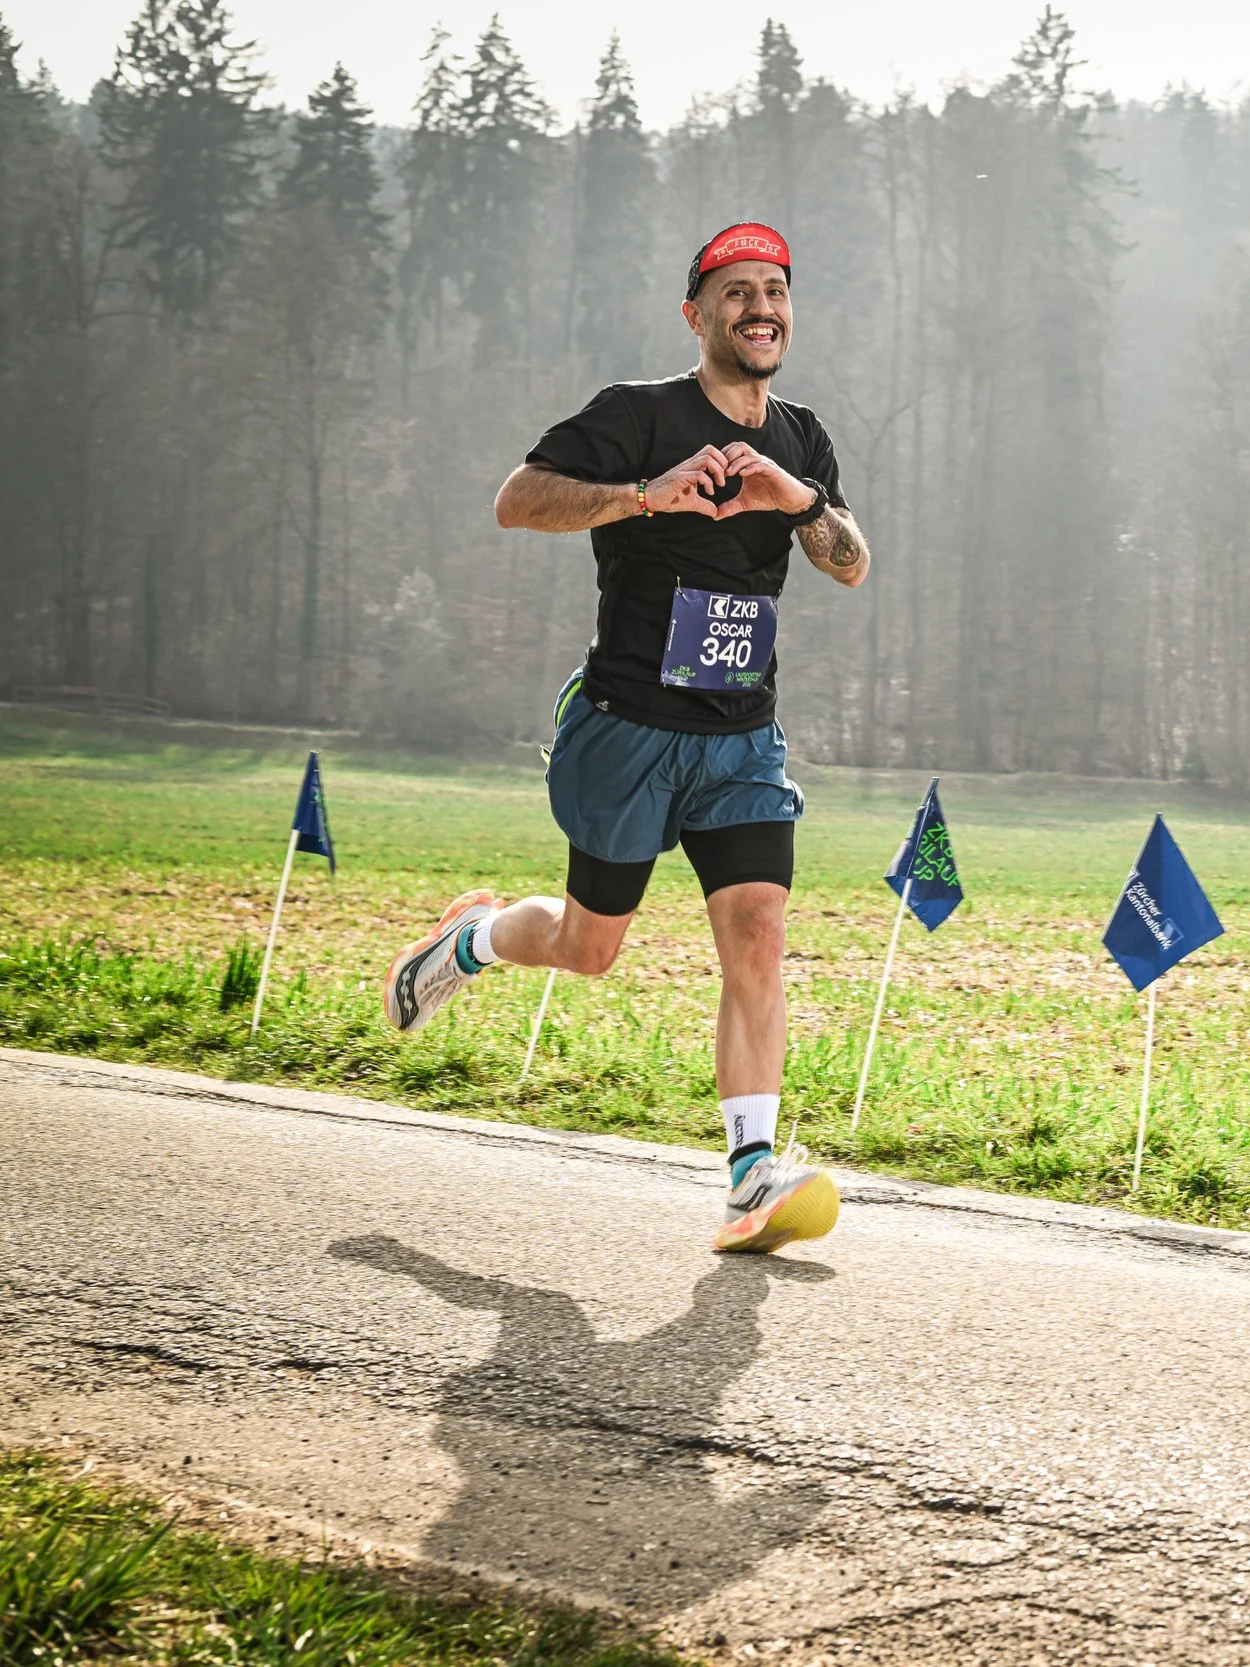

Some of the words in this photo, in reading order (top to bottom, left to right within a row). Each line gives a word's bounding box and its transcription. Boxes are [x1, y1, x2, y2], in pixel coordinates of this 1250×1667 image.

[730, 600, 759, 619] ZKB
[709, 621, 753, 638] OSCAR
[699, 637, 752, 668] 340
[1132, 881, 1162, 917] Zürcher
[1125, 888, 1172, 950] Kantonalbank
